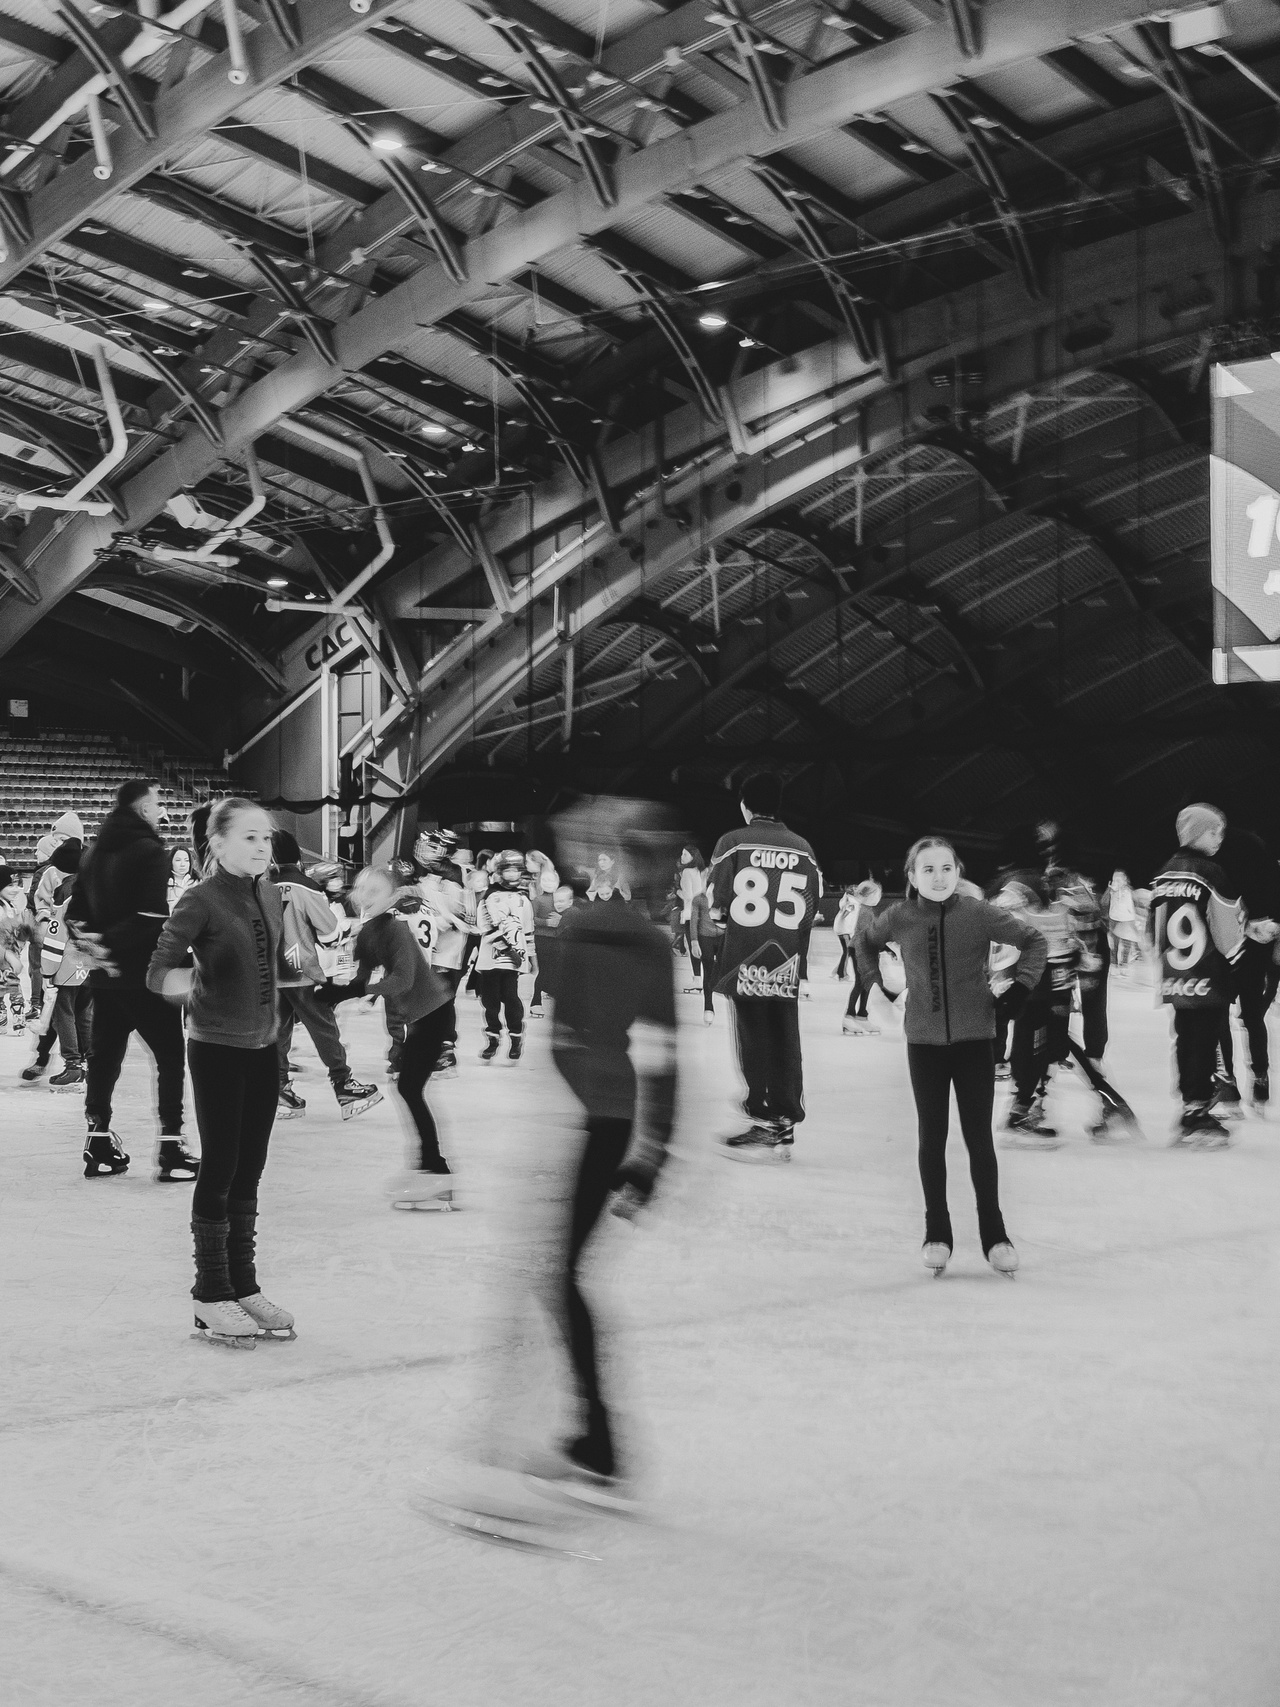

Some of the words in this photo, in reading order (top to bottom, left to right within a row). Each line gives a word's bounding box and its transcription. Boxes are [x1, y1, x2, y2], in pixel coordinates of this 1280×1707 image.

[1246, 495, 1280, 558] 1
[750, 850, 799, 869] СШОР
[730, 866, 808, 930] 85
[49, 920, 59, 935] 8
